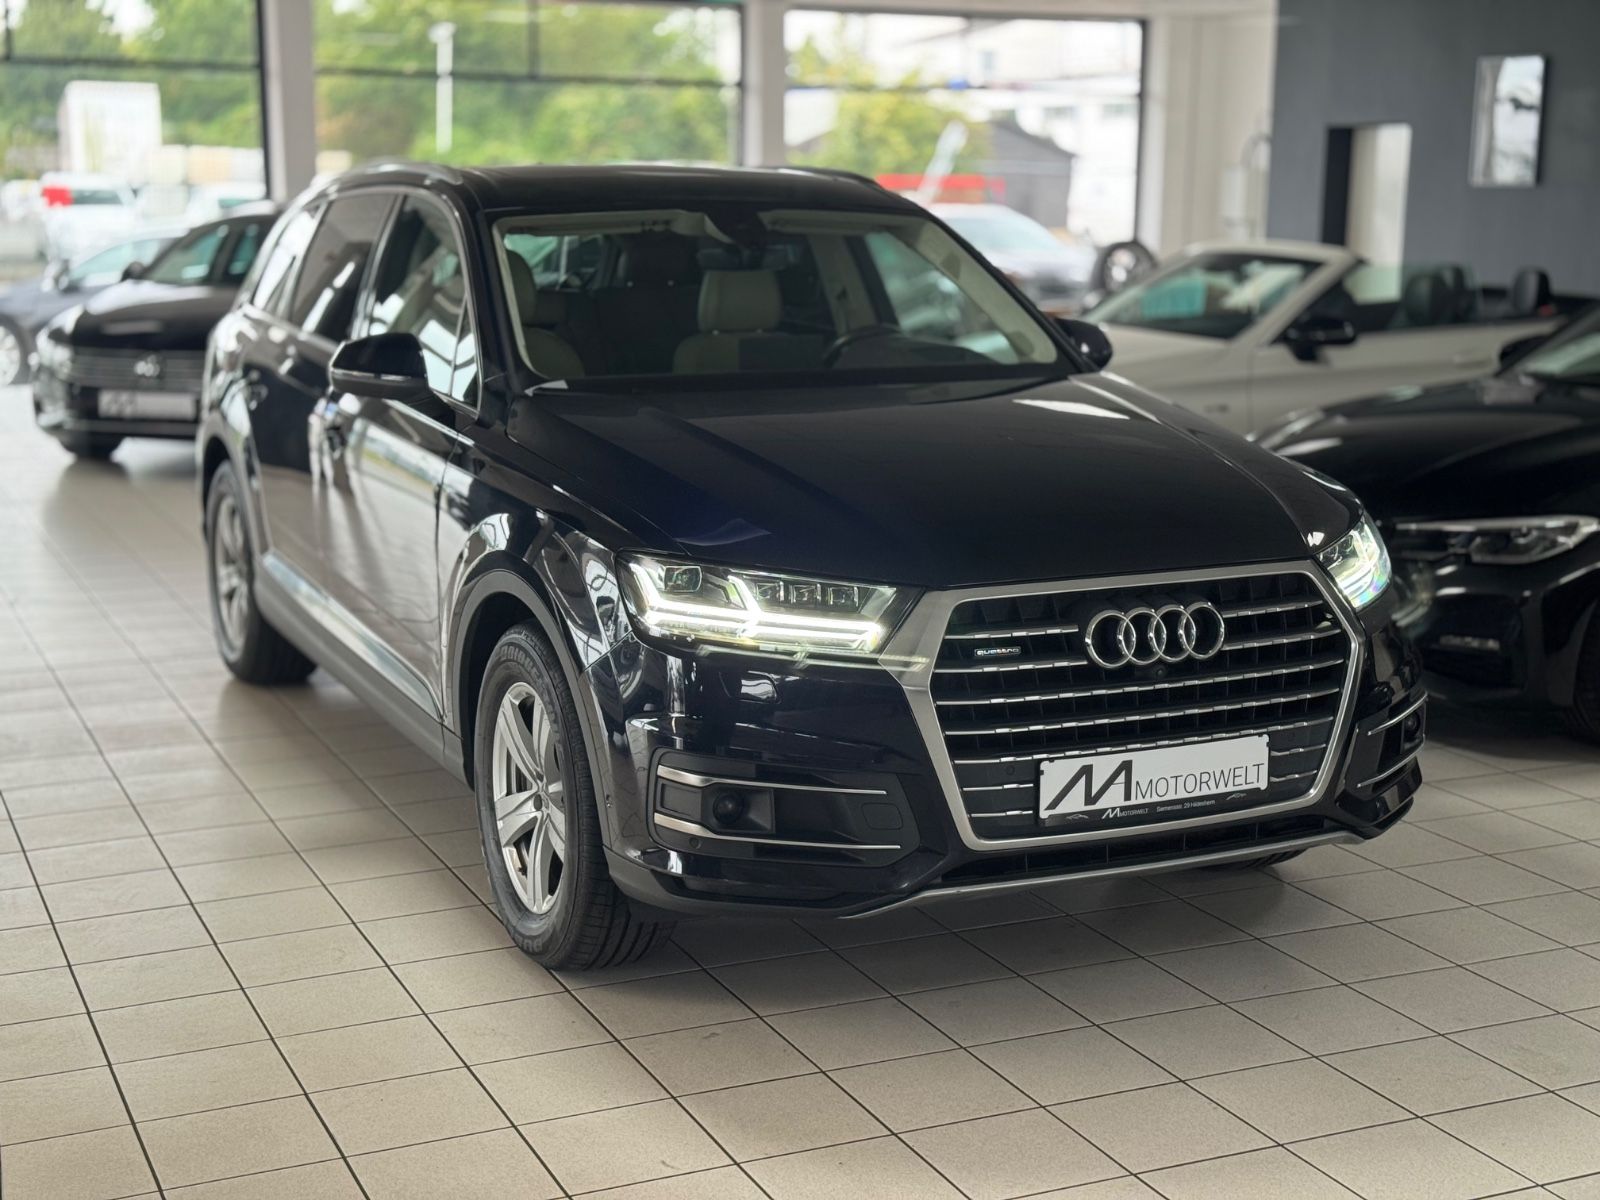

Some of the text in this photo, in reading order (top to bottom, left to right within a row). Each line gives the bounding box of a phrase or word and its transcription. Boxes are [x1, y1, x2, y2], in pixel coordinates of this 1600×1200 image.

[976, 648, 1020, 656] quattro
[1134, 763, 1265, 801] MOTORWELT
[1120, 808, 1149, 817] MOTORWELT
